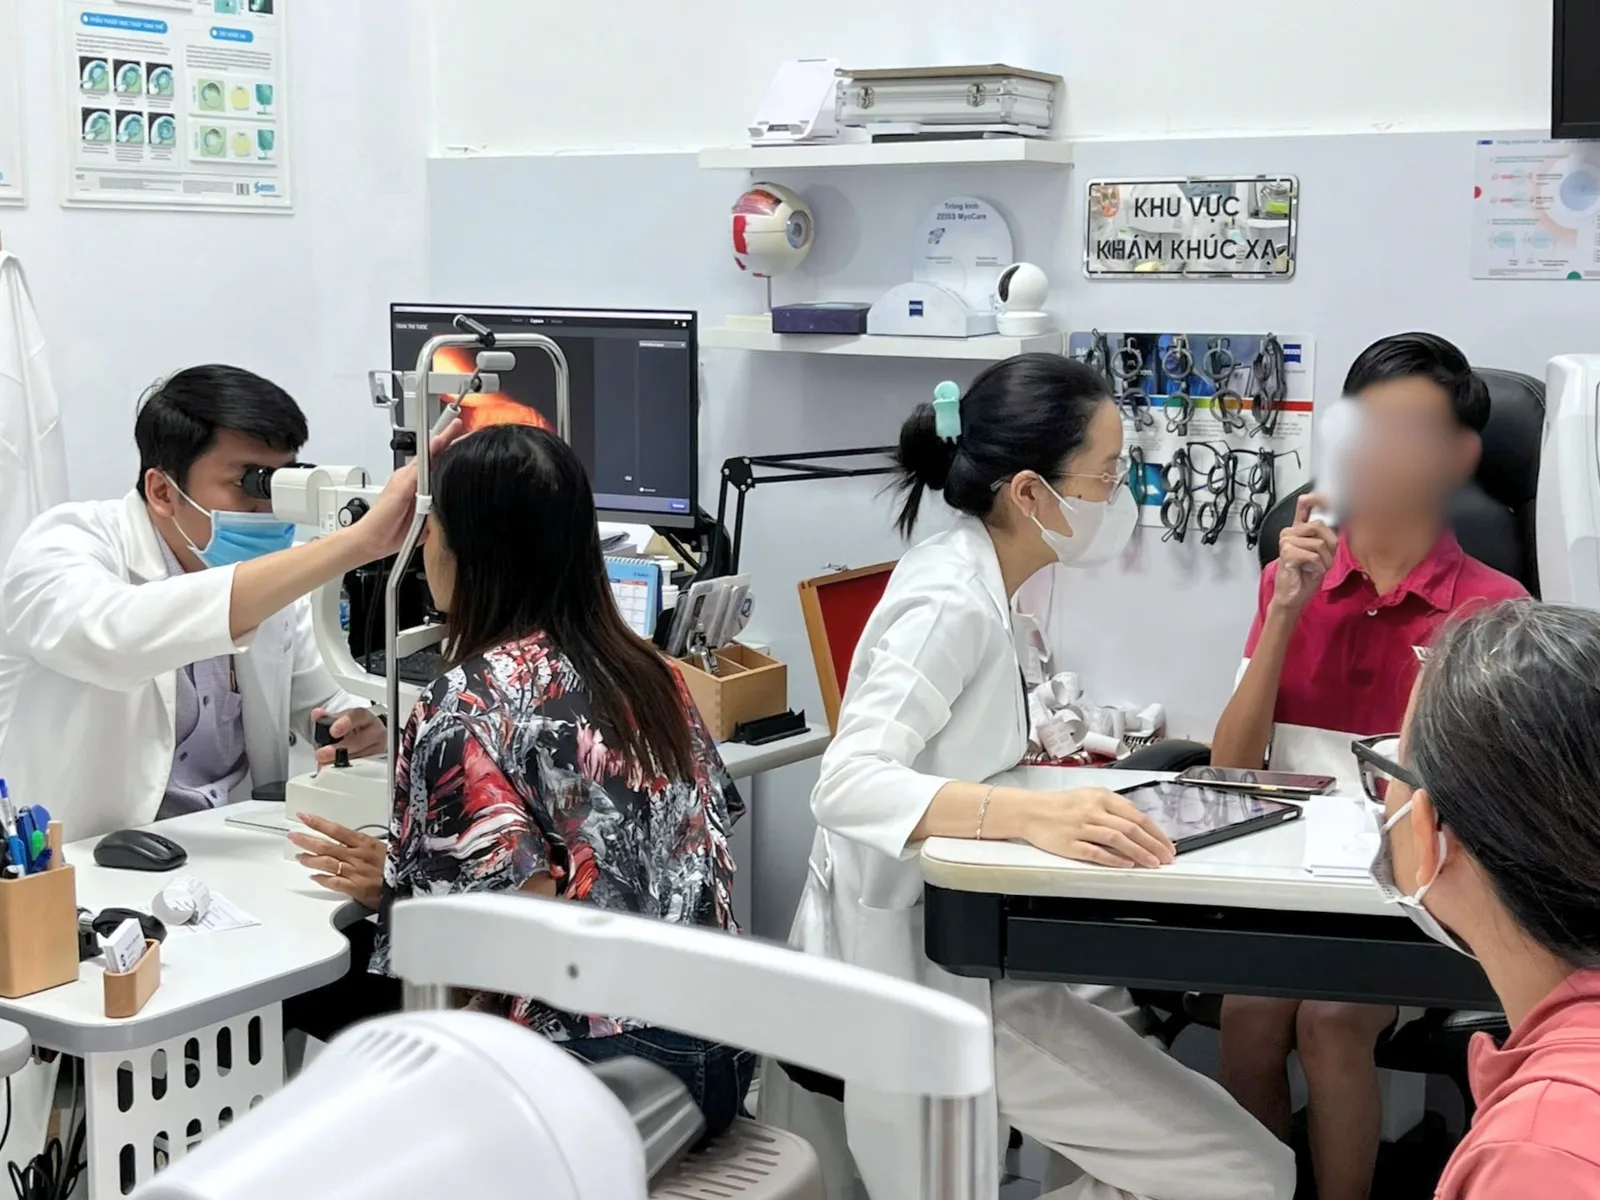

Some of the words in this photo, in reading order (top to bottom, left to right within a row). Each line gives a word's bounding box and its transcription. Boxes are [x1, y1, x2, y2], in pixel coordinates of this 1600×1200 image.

[1134, 197, 1181, 218] KHU
[1189, 194, 1240, 223] VỰC
[1097, 234, 1162, 260] KHÁM
[1171, 234, 1237, 260] KHÚC
[1245, 239, 1277, 266] XẠ
